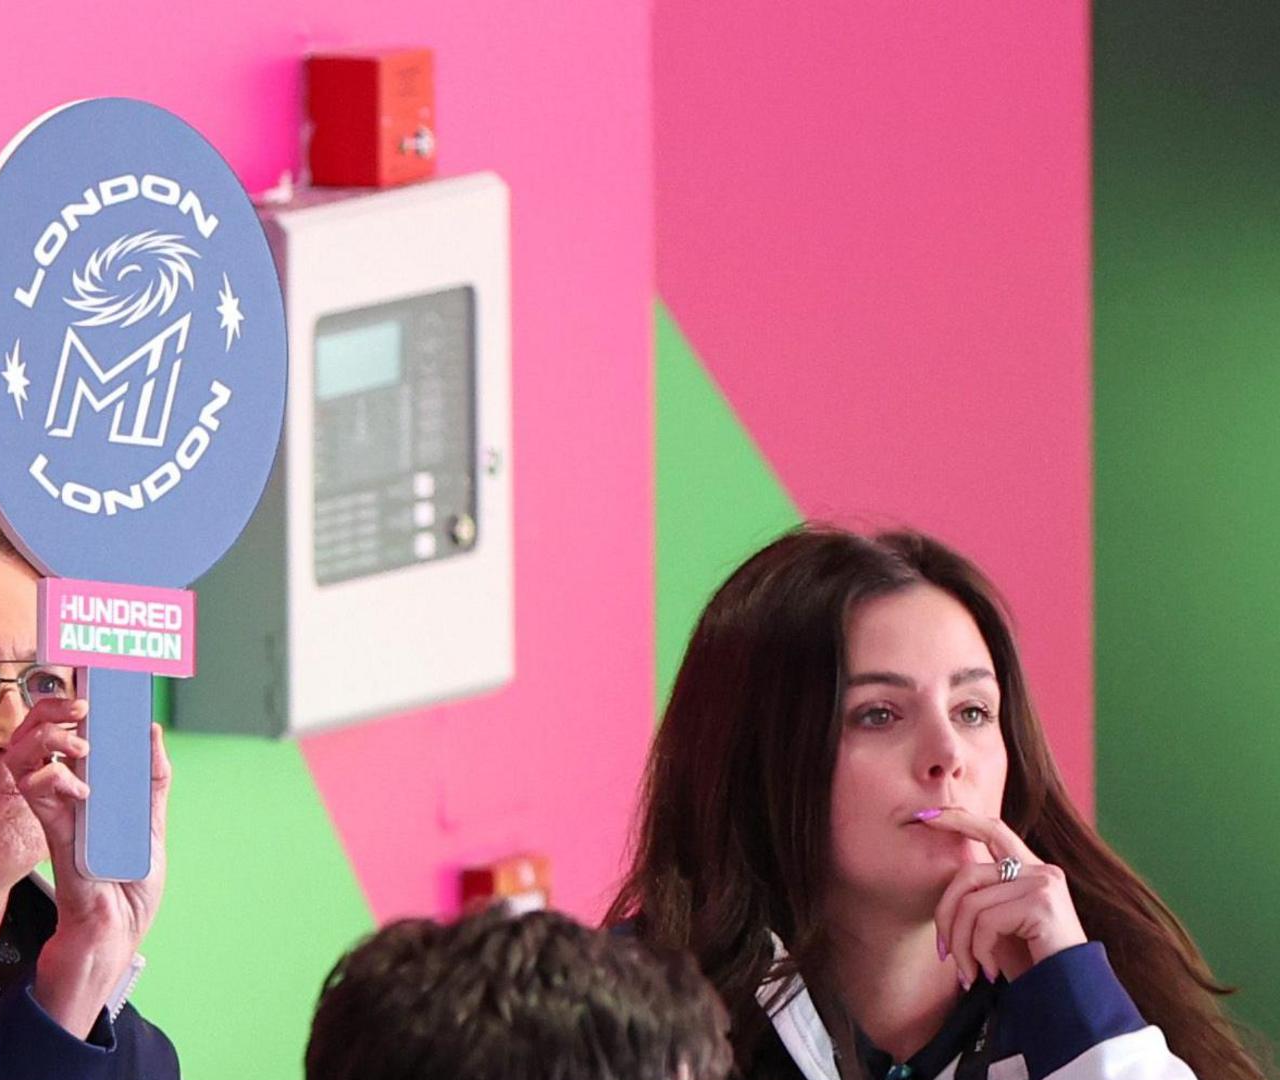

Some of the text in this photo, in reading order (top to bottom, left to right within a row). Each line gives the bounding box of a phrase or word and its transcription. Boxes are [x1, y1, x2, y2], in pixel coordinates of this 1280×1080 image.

[14, 174, 219, 308] LONDON
[45, 313, 192, 447] MI
[29, 380, 232, 516] LONDON
[59, 622, 182, 661] AUCTION
[60, 594, 183, 630] HUNDRED
